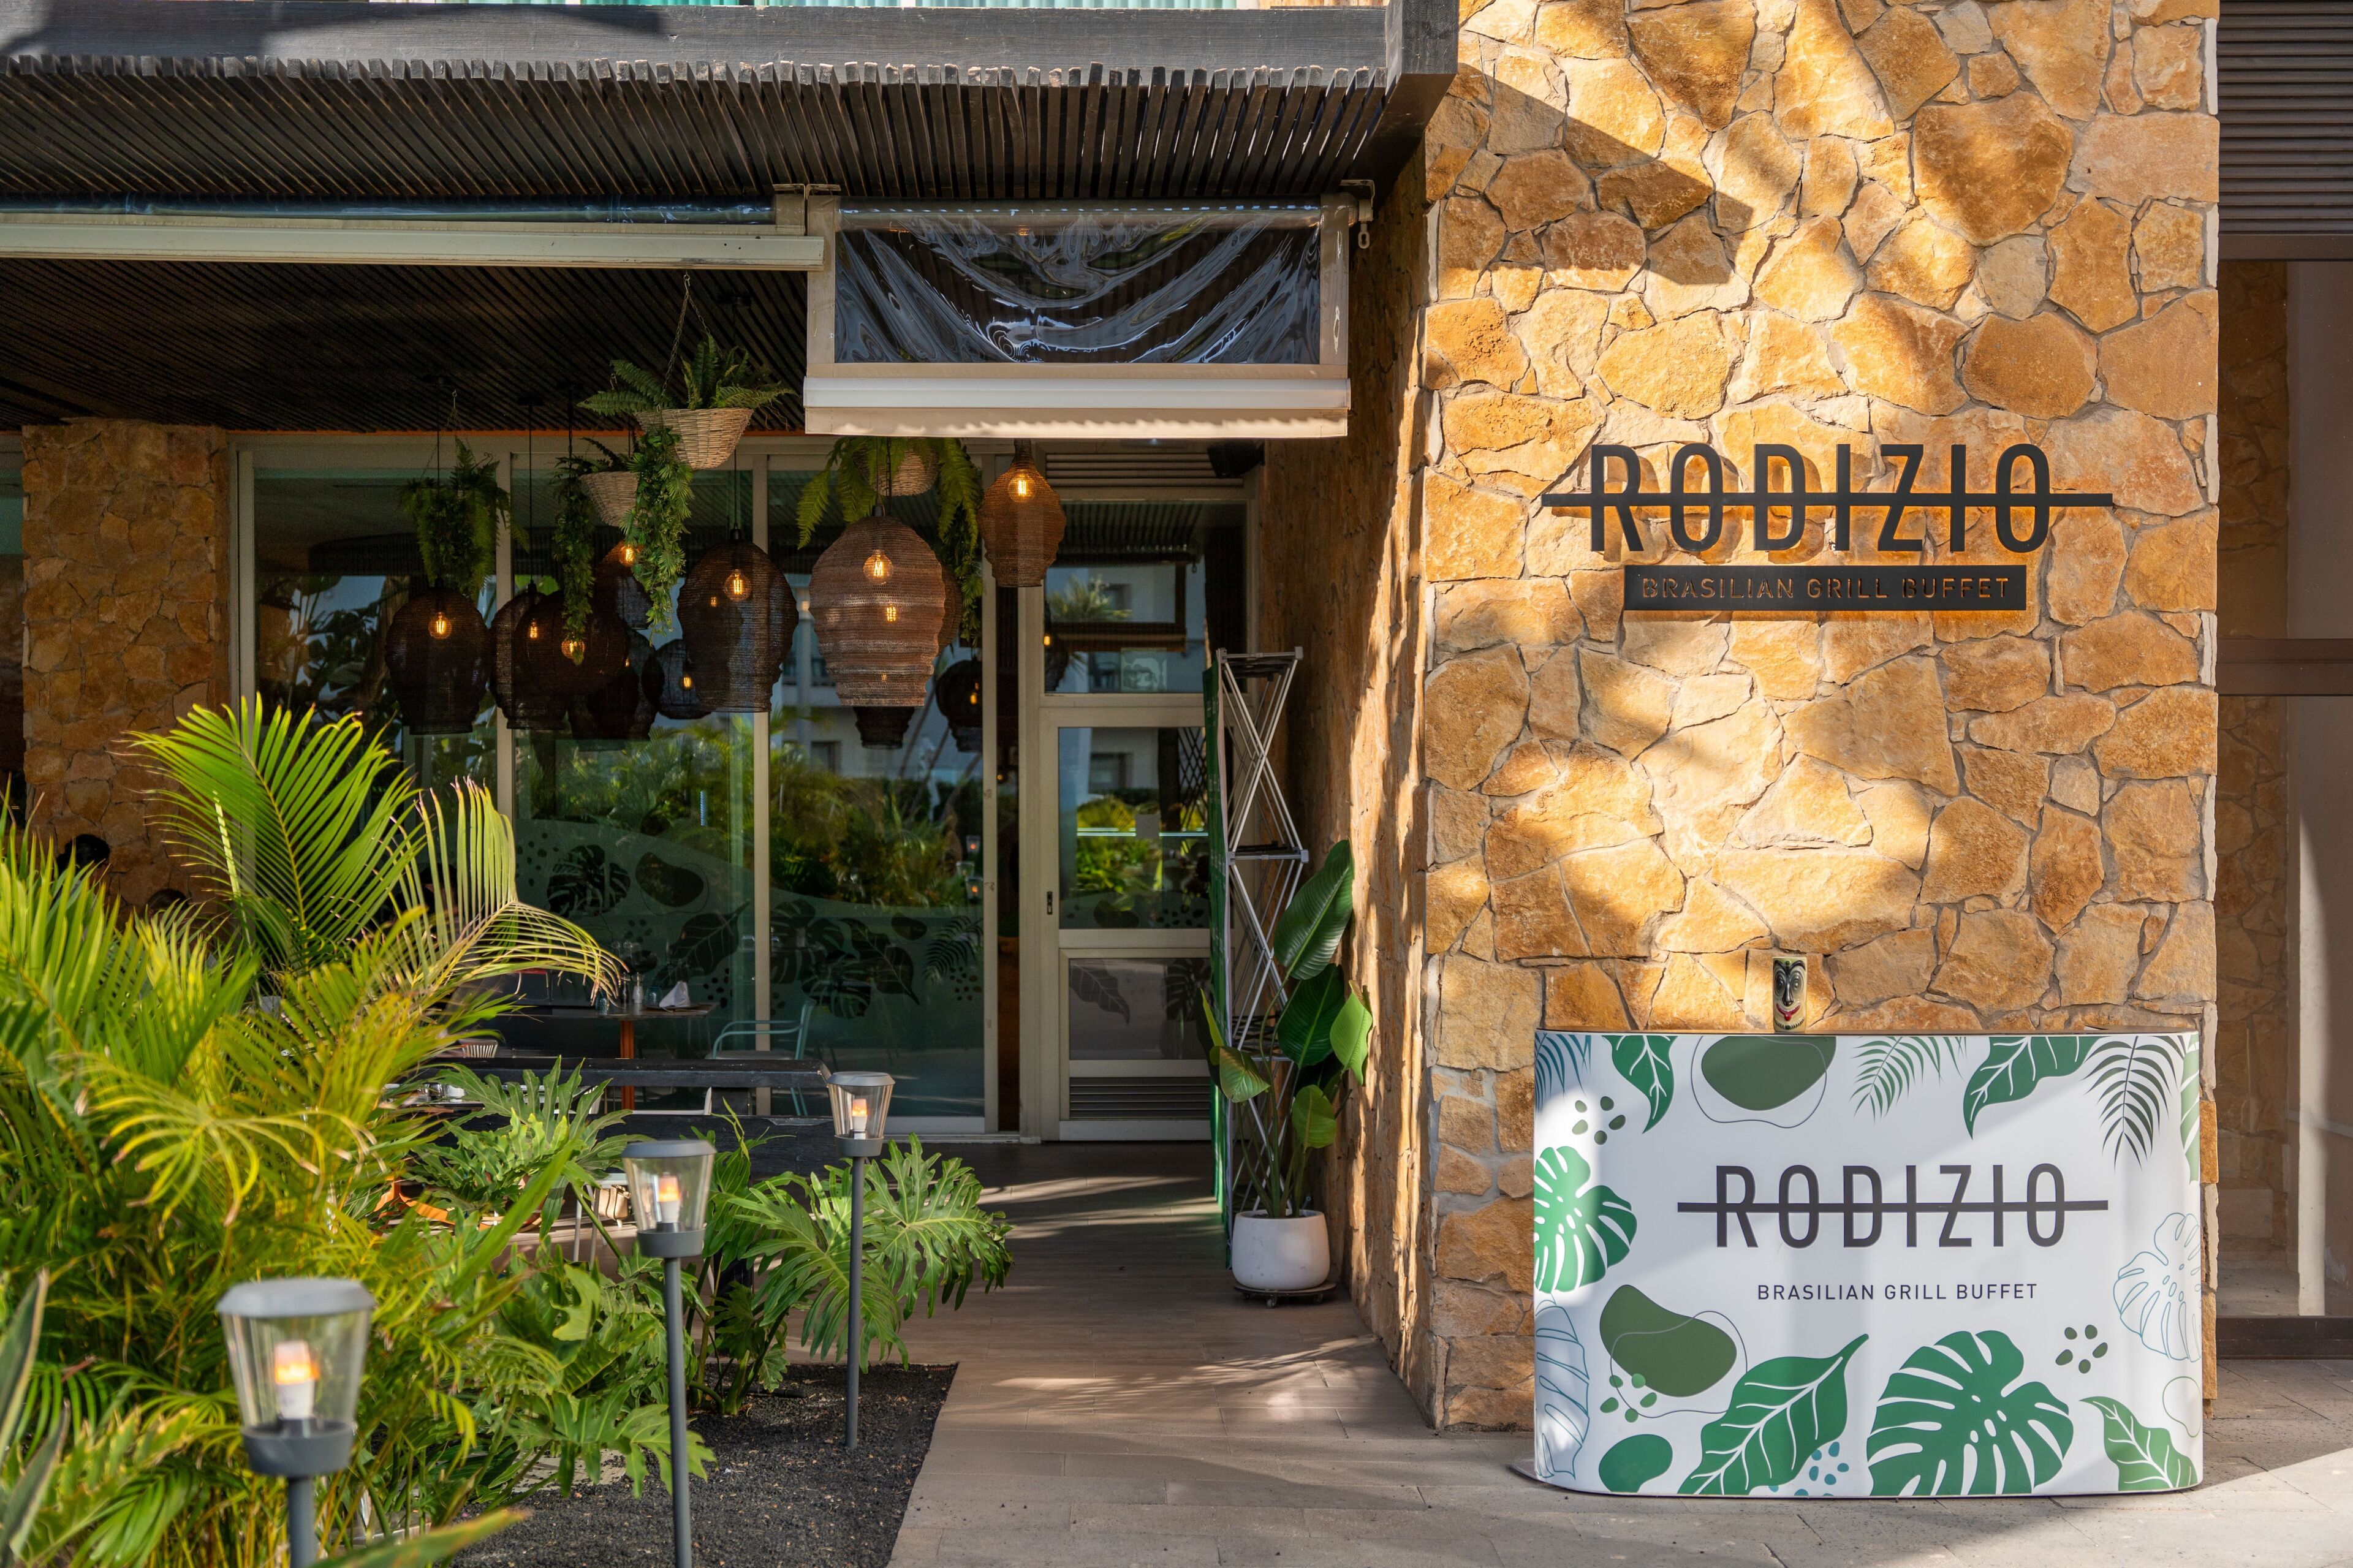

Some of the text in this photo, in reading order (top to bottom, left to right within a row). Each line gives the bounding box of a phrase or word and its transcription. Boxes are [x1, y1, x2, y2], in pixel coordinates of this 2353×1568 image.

[1590, 443, 2050, 553] RODIZIO
[1642, 578, 2010, 599] BRASILIAN GRILL BUFFET
[1716, 1163, 2066, 1249] RODIZIO
[1757, 1283, 2037, 1300] BRASILIAN GRILL BUFFET
